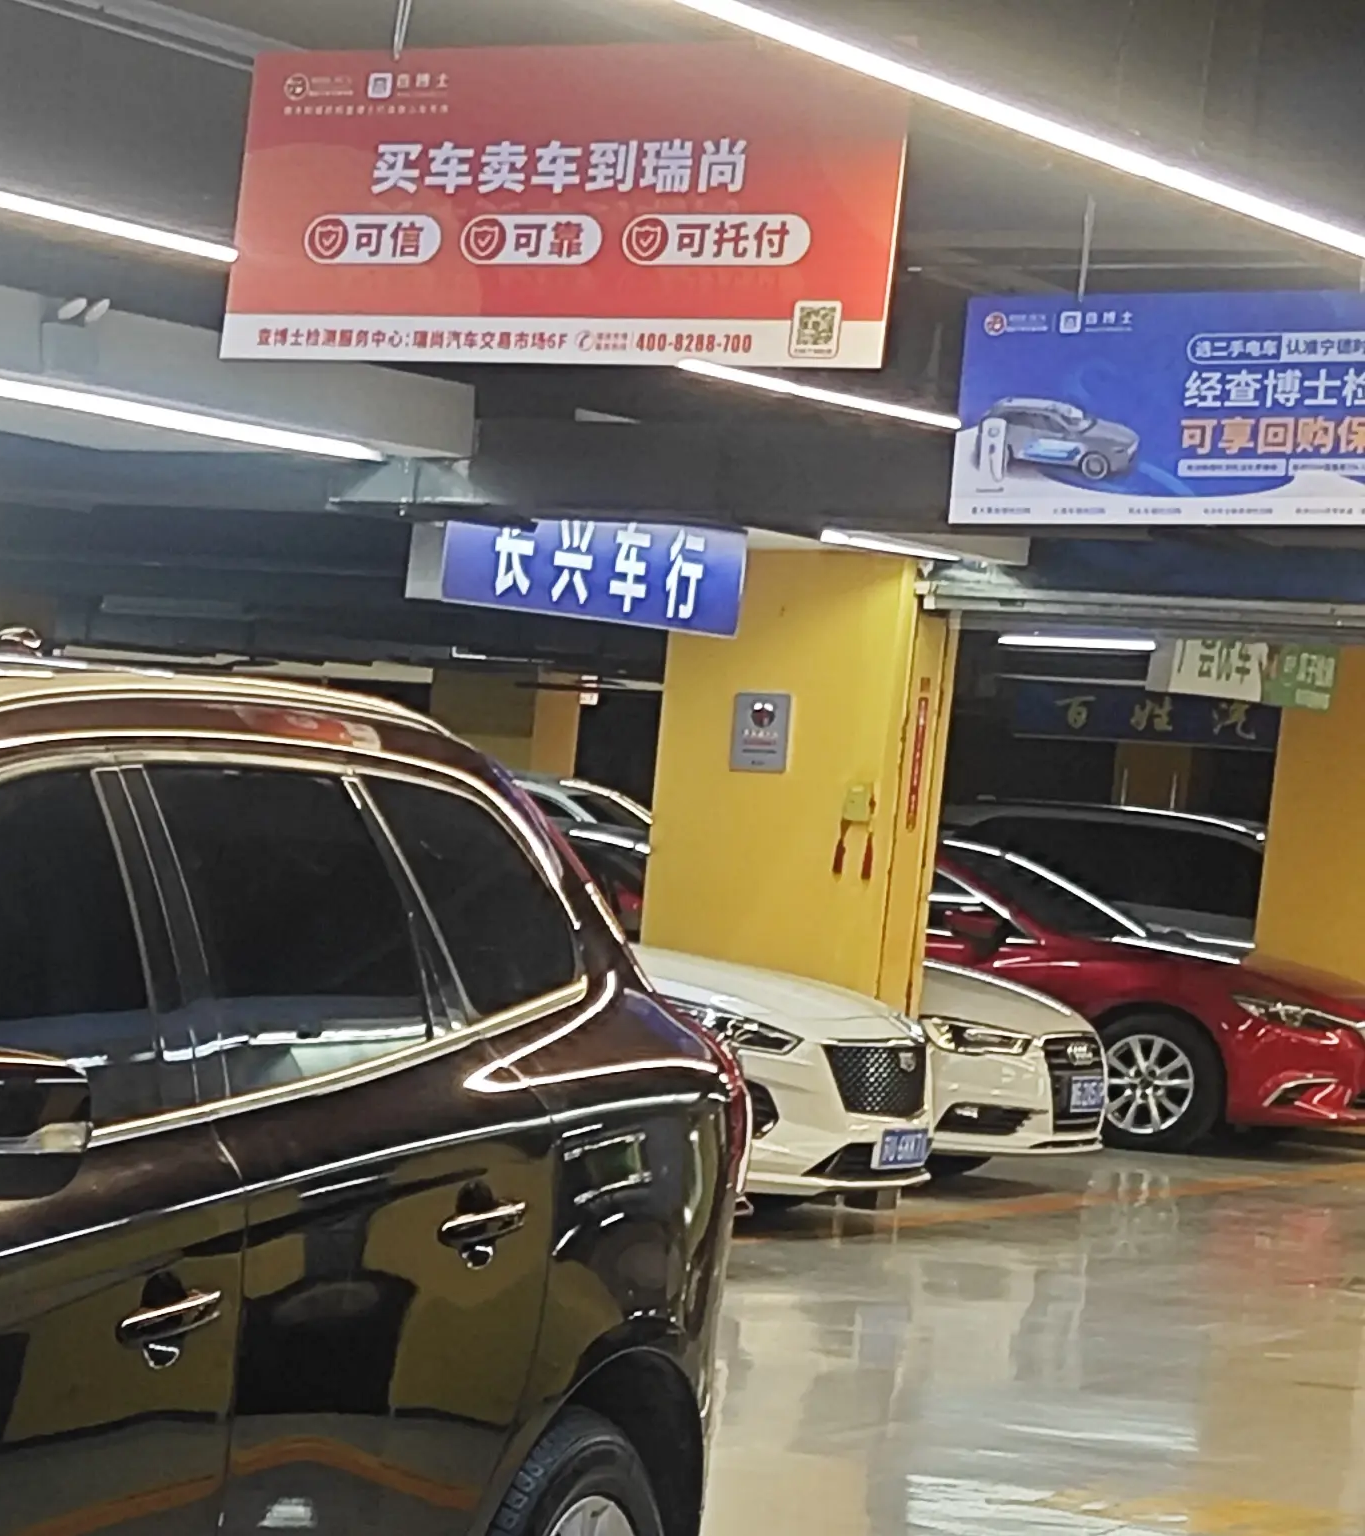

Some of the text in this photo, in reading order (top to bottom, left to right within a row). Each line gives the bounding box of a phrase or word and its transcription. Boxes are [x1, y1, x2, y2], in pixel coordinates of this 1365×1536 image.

[370, 138, 748, 196] 买车卖车到瑞尚
[354, 221, 789, 259] 可信 可靠 可托付
[492, 519, 707, 619] 长兴车行
